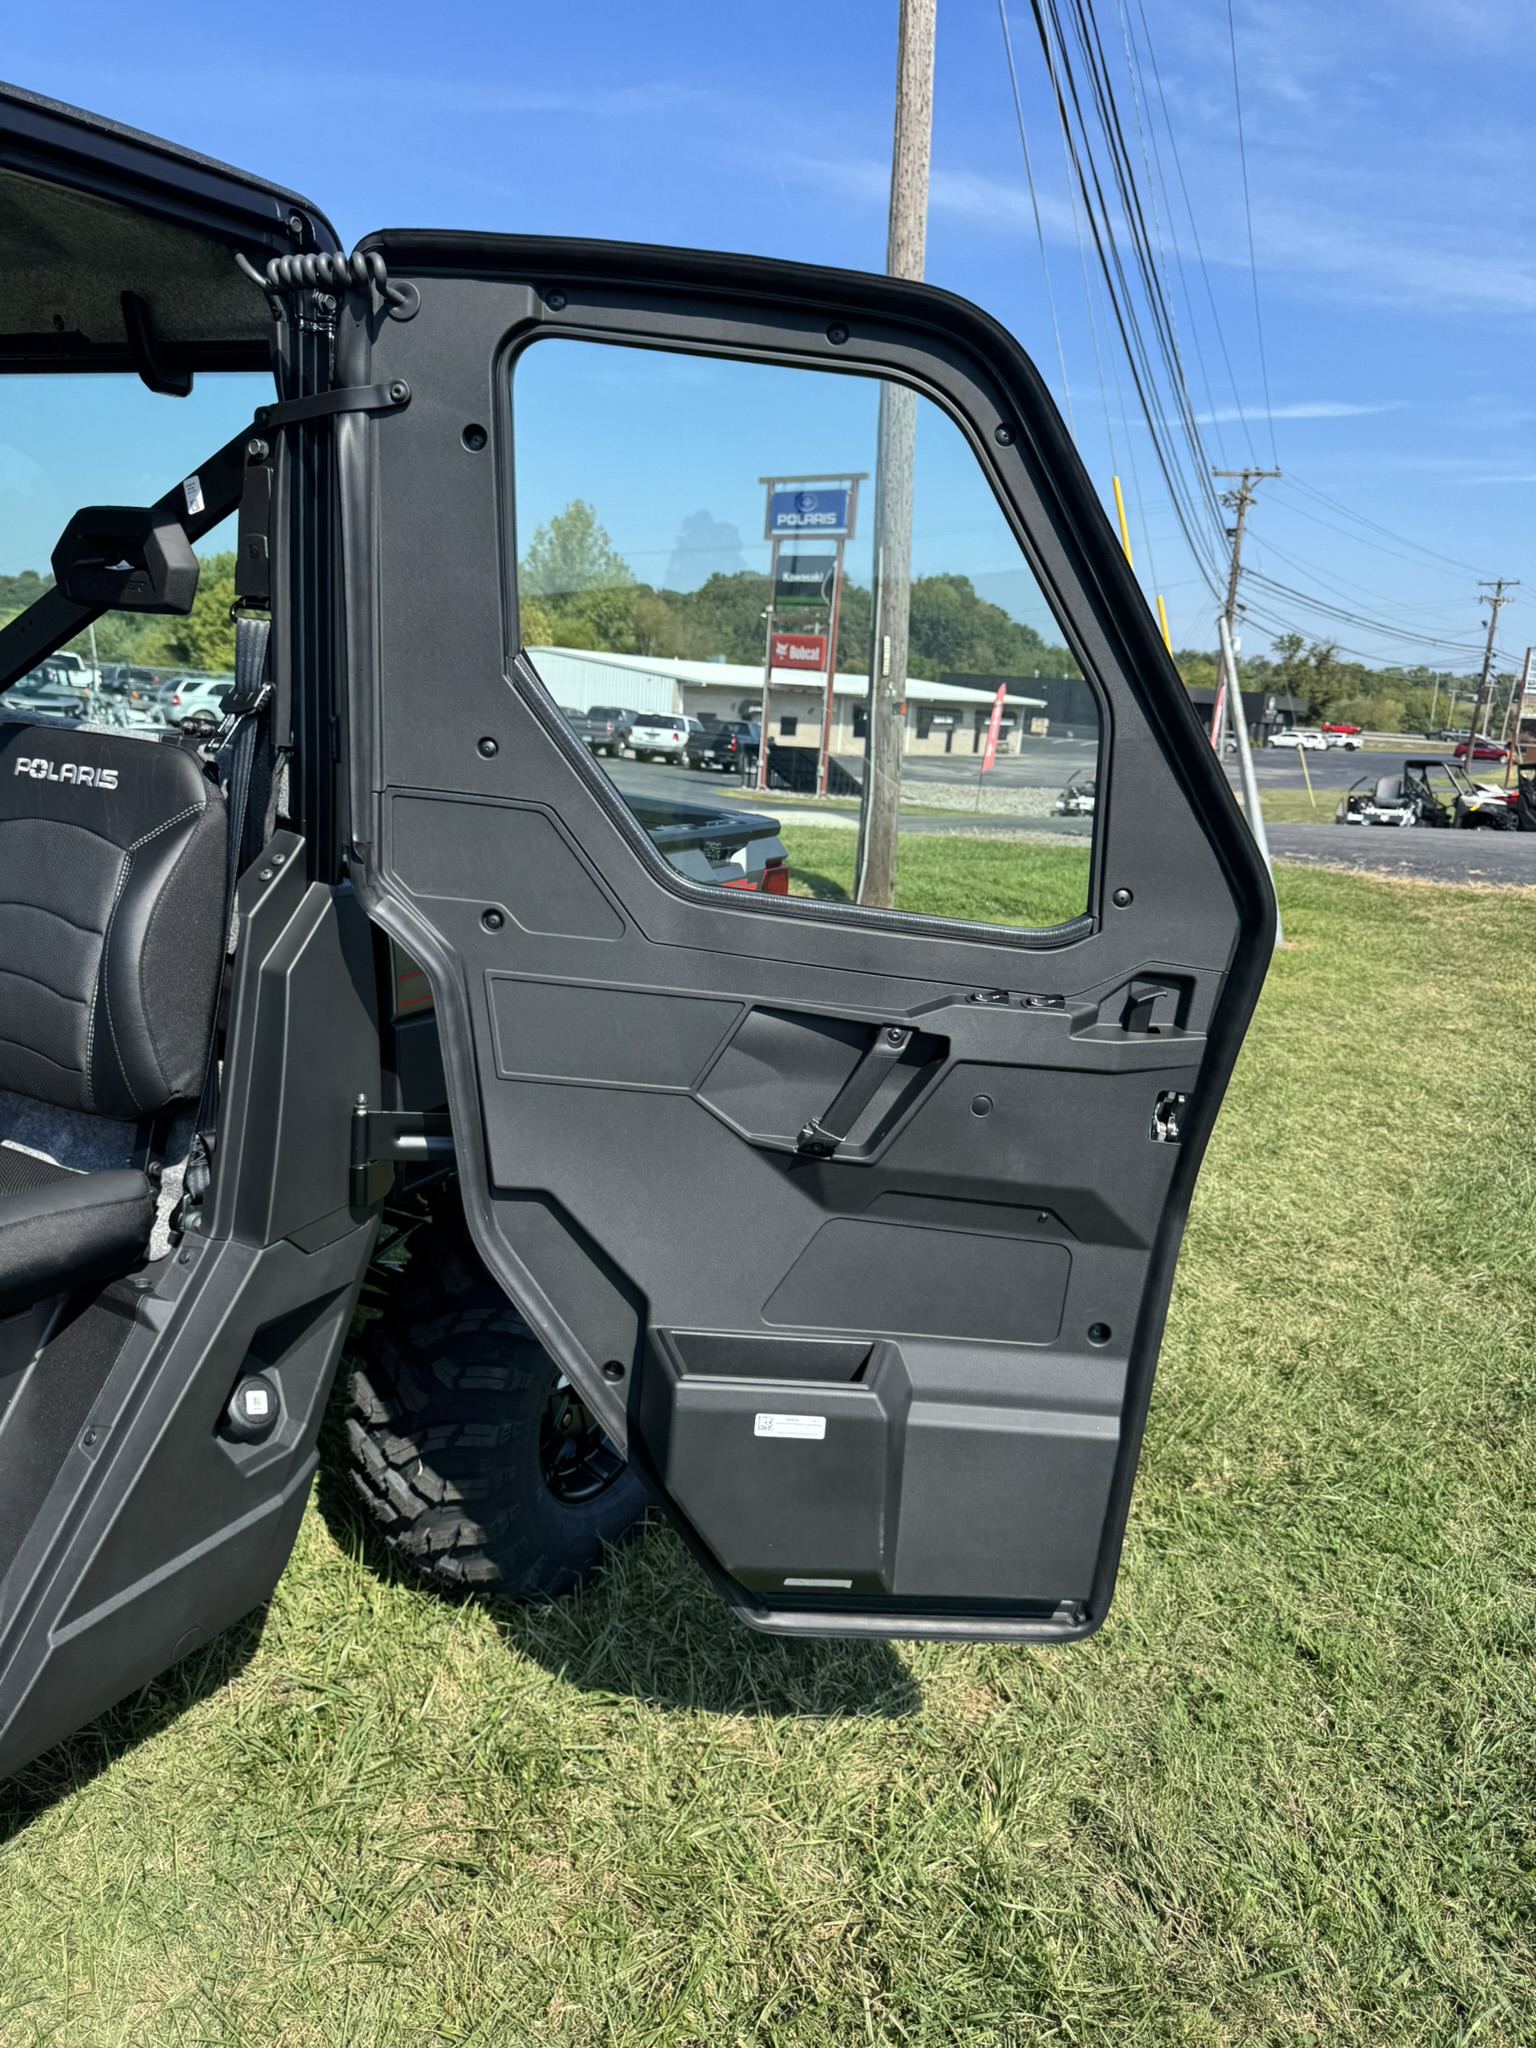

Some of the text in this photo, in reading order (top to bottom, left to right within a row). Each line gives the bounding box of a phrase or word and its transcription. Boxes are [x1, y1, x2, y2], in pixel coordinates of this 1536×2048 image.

[777, 512, 837, 526] POLARIS
[782, 571, 824, 582] Kawasaki
[789, 645, 820, 661] Bobcat
[13, 757, 119, 790] POLARIS
